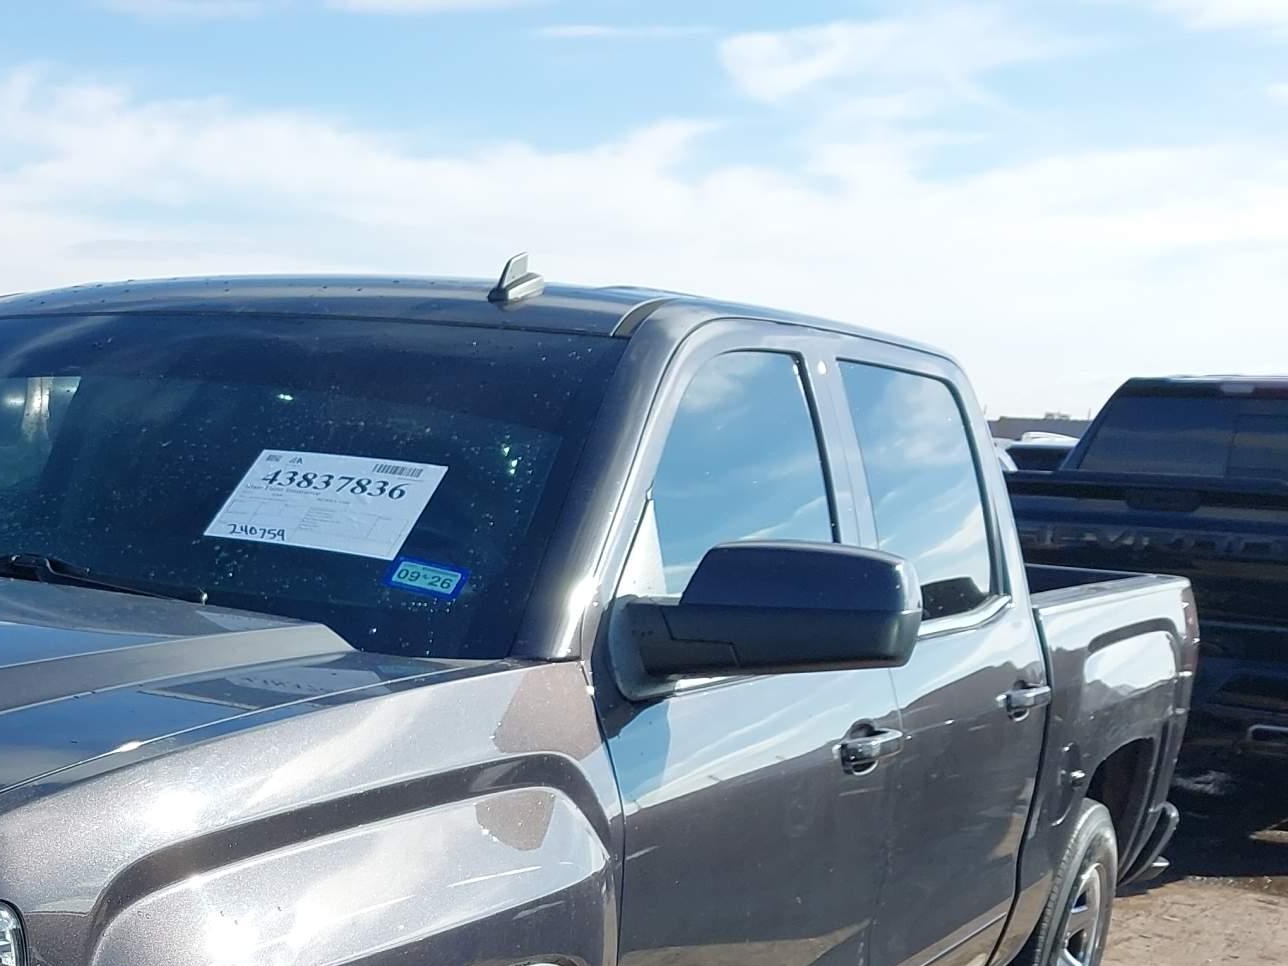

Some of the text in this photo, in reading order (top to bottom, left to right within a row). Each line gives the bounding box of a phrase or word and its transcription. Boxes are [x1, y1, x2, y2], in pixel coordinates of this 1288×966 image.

[262, 469, 410, 500] 43837836
[229, 523, 286, 542] 240759
[397, 568, 453, 589] 09 26
